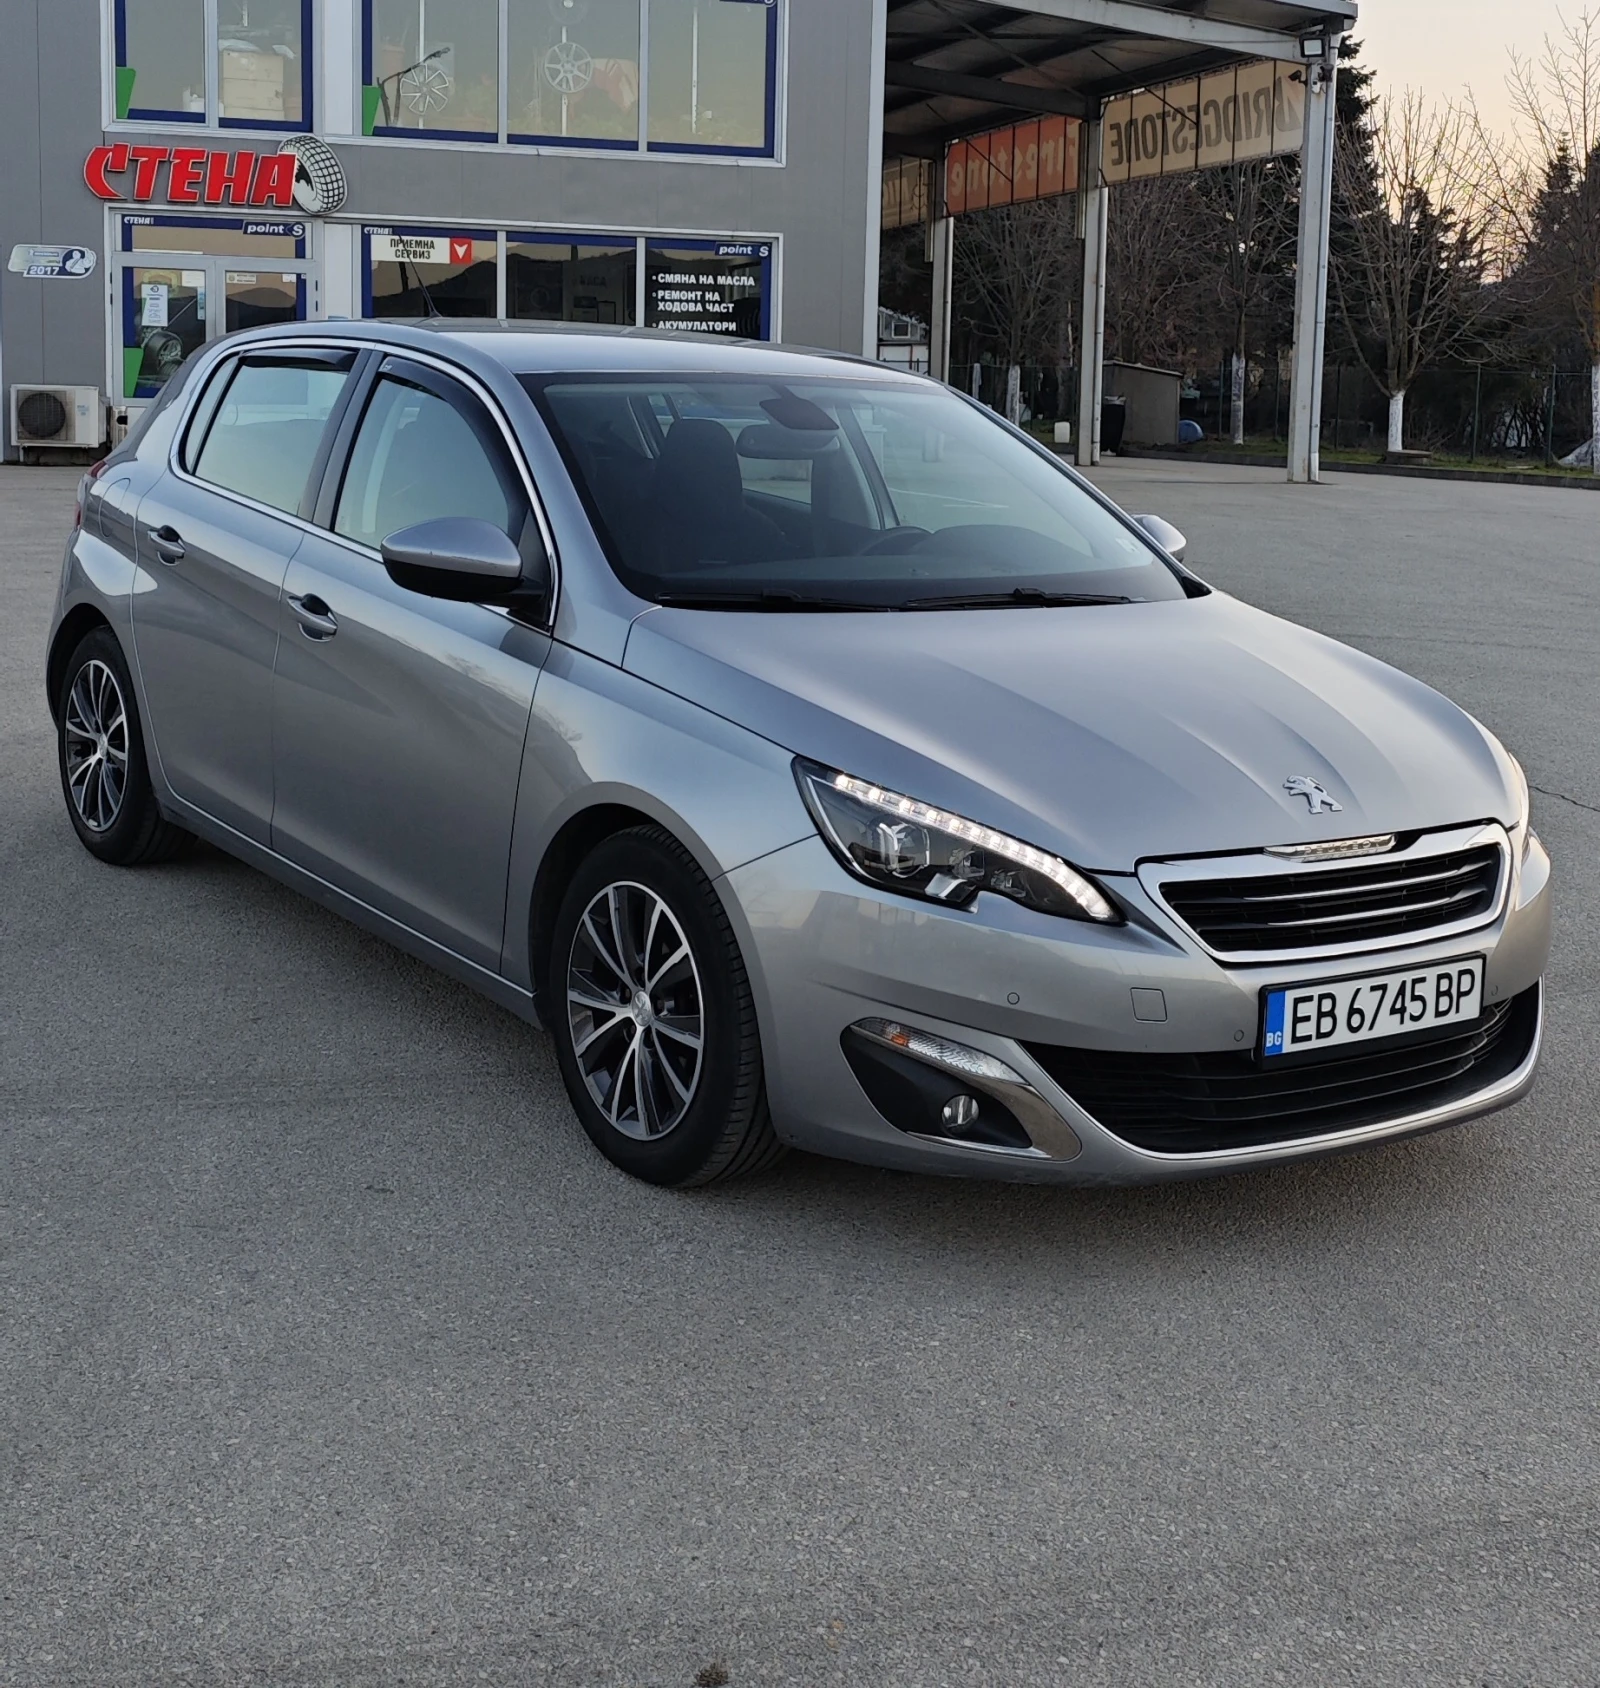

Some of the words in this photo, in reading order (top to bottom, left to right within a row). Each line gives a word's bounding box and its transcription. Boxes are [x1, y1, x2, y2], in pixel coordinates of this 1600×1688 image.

[83, 143, 298, 206] СТЕНА
[124, 216, 150, 225] СТЕНА
[247, 223, 285, 234] point
[292, 224, 303, 236] S
[390, 238, 436, 250] ПРИЕМНА
[394, 249, 431, 260] СЕРВИЗ
[719, 244, 753, 255] point
[759, 245, 769, 257] S
[29, 266, 60, 276] 2017
[657, 273, 697, 284] СМЯНА
[699, 274, 715, 285] НА
[717, 275, 755, 286] МАСЛА
[657, 290, 703, 300] РЕМОНТ
[705, 291, 721, 301] НА
[657, 301, 704, 313] ХОДОВА
[706, 303, 735, 313] ЧАСТ
[657, 320, 737, 331] АКУМУЛАТОРИ
[1290, 992, 1338, 1044] EB
[1346, 976, 1428, 1034] 6745
[1434, 968, 1476, 1019] BP
[1266, 1032, 1282, 1048] BG
